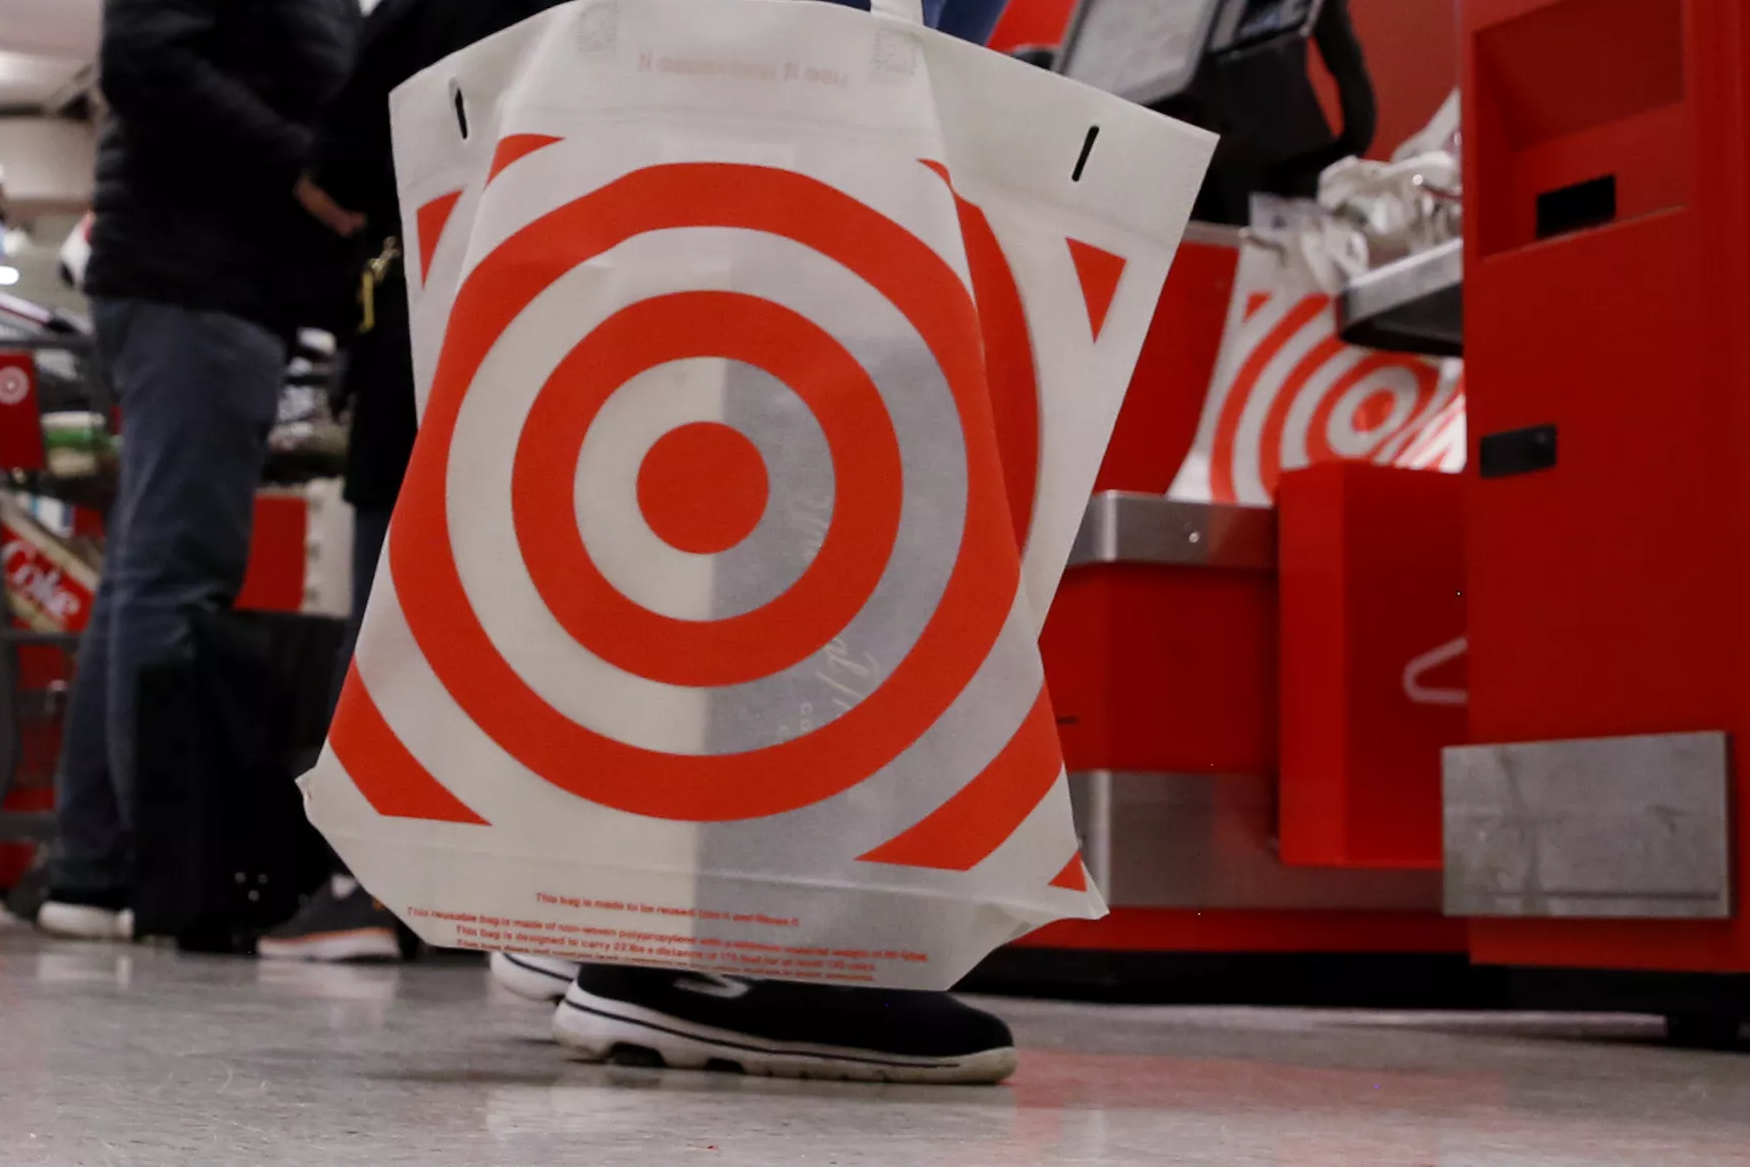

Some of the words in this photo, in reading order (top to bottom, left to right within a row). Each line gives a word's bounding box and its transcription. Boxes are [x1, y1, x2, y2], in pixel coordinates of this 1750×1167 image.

[1, 540, 80, 619] Coke
[536, 892, 557, 904] This
[560, 896, 581, 908] bag
[583, 898, 592, 907] is
[594, 900, 624, 910] made
[480, 915, 499, 927] bag
[456, 925, 477, 937] This
[480, 928, 500, 940] bag
[516, 933, 565, 945] designed
[580, 940, 610, 952] carry
